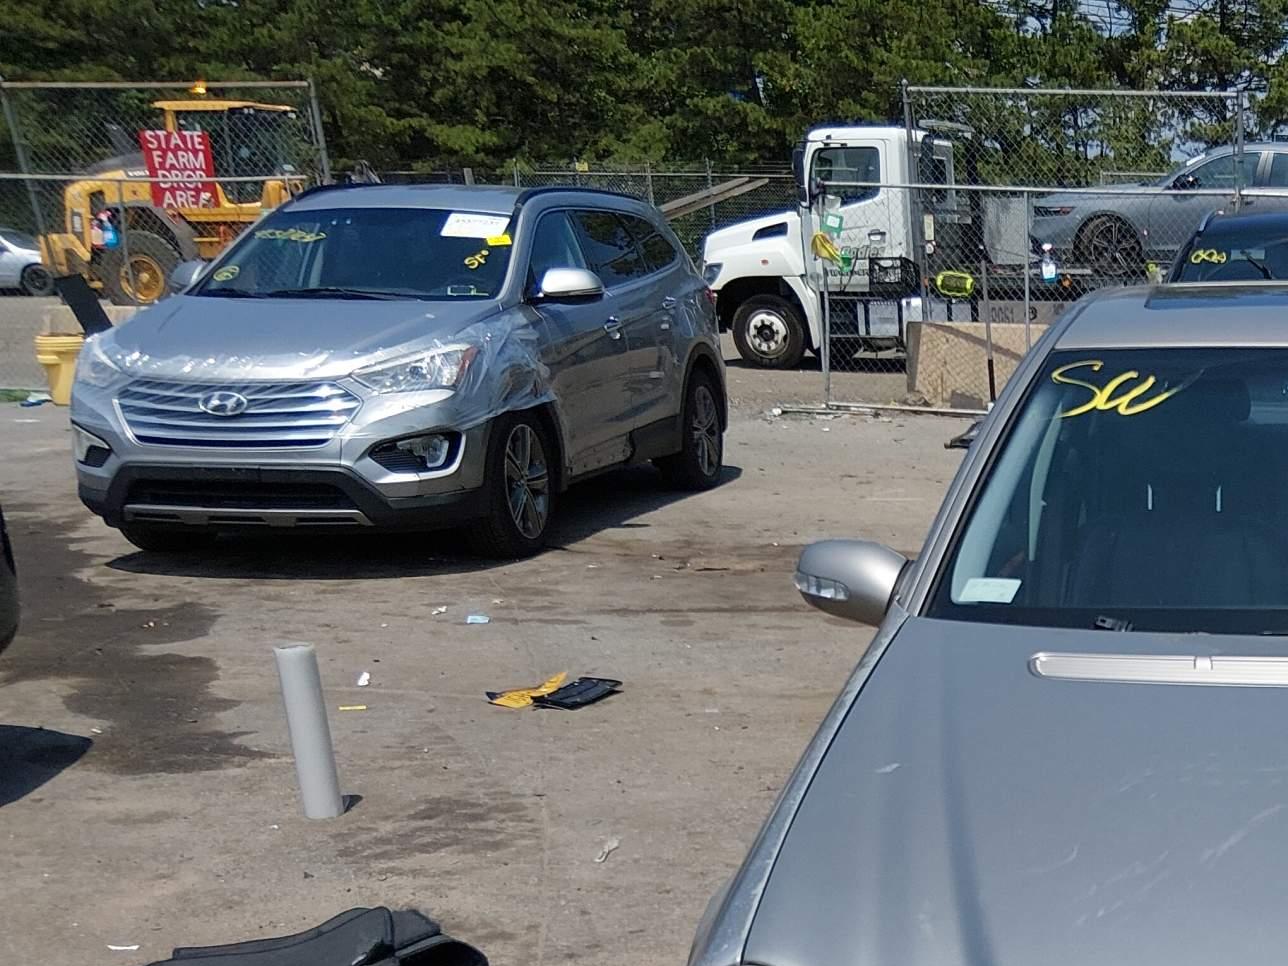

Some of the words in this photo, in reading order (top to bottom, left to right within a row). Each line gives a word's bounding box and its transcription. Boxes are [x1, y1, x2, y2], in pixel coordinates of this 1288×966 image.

[144, 130, 205, 149] STATE
[152, 150, 206, 169] FARM
[157, 170, 206, 188] DROP
